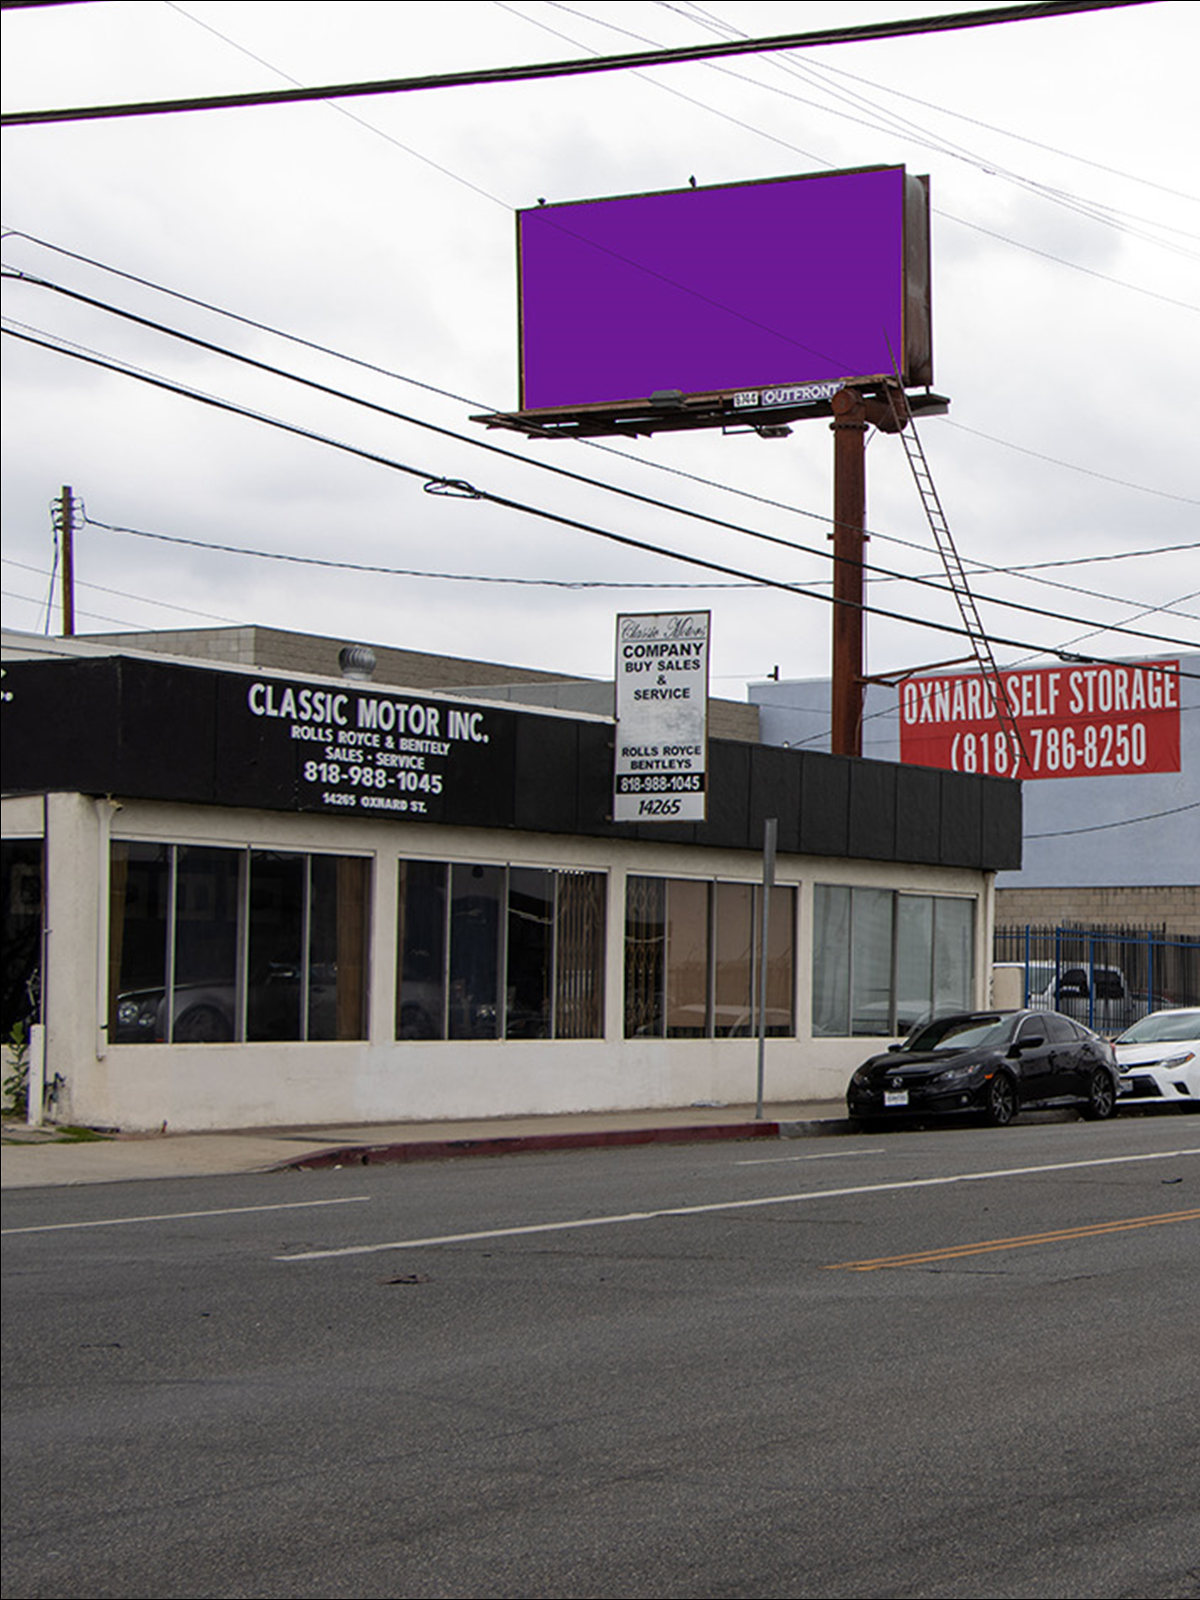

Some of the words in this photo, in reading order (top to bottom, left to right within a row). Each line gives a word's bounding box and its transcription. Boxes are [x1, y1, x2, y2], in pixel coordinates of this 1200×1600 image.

[765, 384, 840, 402] OUTFRONT
[623, 642, 703, 658] COMPANY
[625, 660, 652, 673] BUY
[657, 659, 700, 671] SALES
[657, 674, 666, 686] &
[633, 687, 691, 700] SERVICE
[903, 678, 997, 725] OXNARD
[1006, 673, 1061, 718] SELF
[1069, 665, 1178, 714] STORAGE
[248, 683, 348, 726] CLASSIC
[357, 698, 440, 737] MOTOR
[448, 710, 490, 743] INC.
[290, 725, 333, 743] ROLLS
[337, 730, 381, 748] ROYCE
[385, 736, 395, 750] &
[399, 737, 451, 756] BENTELY
[325, 746, 364, 763] SALES
[375, 752, 425, 771] SERVICE
[621, 746, 659, 757] ROLLS
[662, 745, 702, 756] ROYCE
[951, 729, 1020, 779] (818)
[1030, 722, 1147, 772] 786-8250
[630, 759, 692, 770] BENTLEYS
[303, 761, 443, 794] 818-988-1045
[620, 775, 701, 792] 818-988-1045
[322, 792, 356, 807] 14265
[360, 796, 408, 812] OXNARD
[410, 800, 427, 813] ST.
[638, 799, 682, 815] 14265
